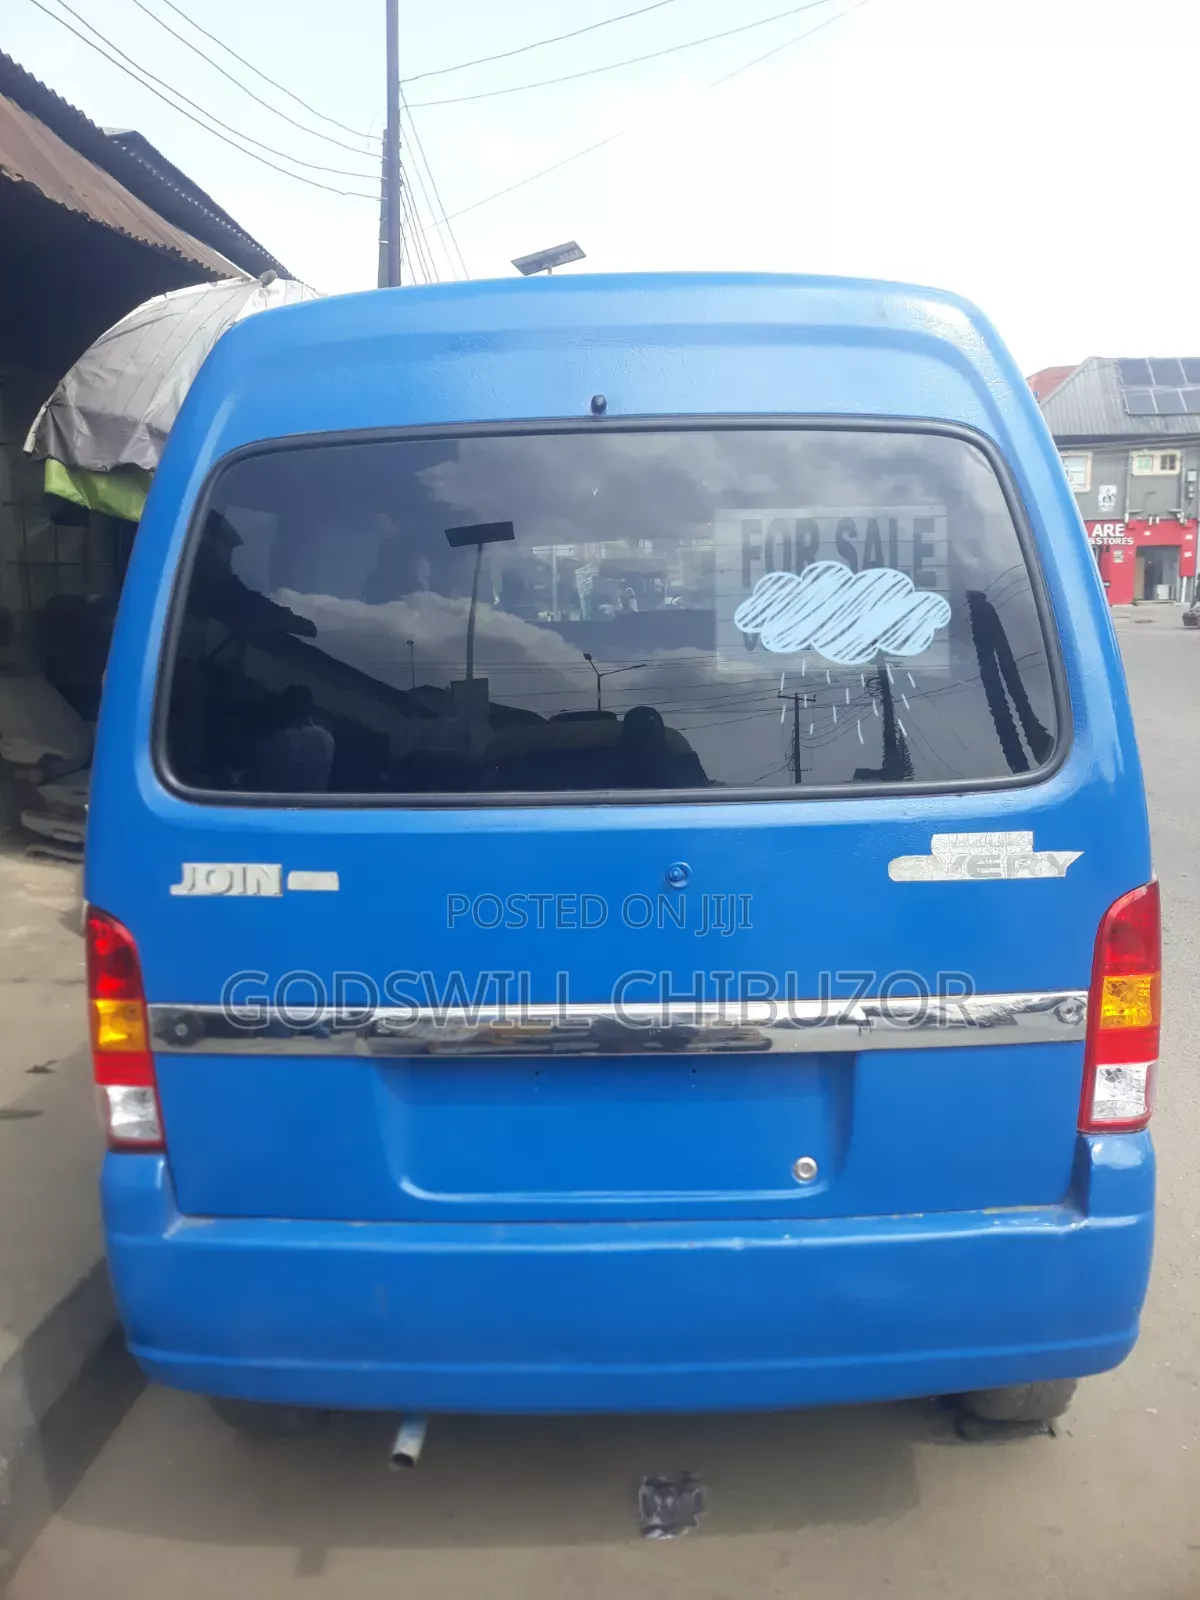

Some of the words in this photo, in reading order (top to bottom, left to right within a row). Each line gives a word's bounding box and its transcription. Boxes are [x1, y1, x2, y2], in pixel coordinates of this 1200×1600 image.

[741, 517, 820, 588] FOR
[835, 516, 936, 588] SALE
[170, 862, 283, 897] JOIN
